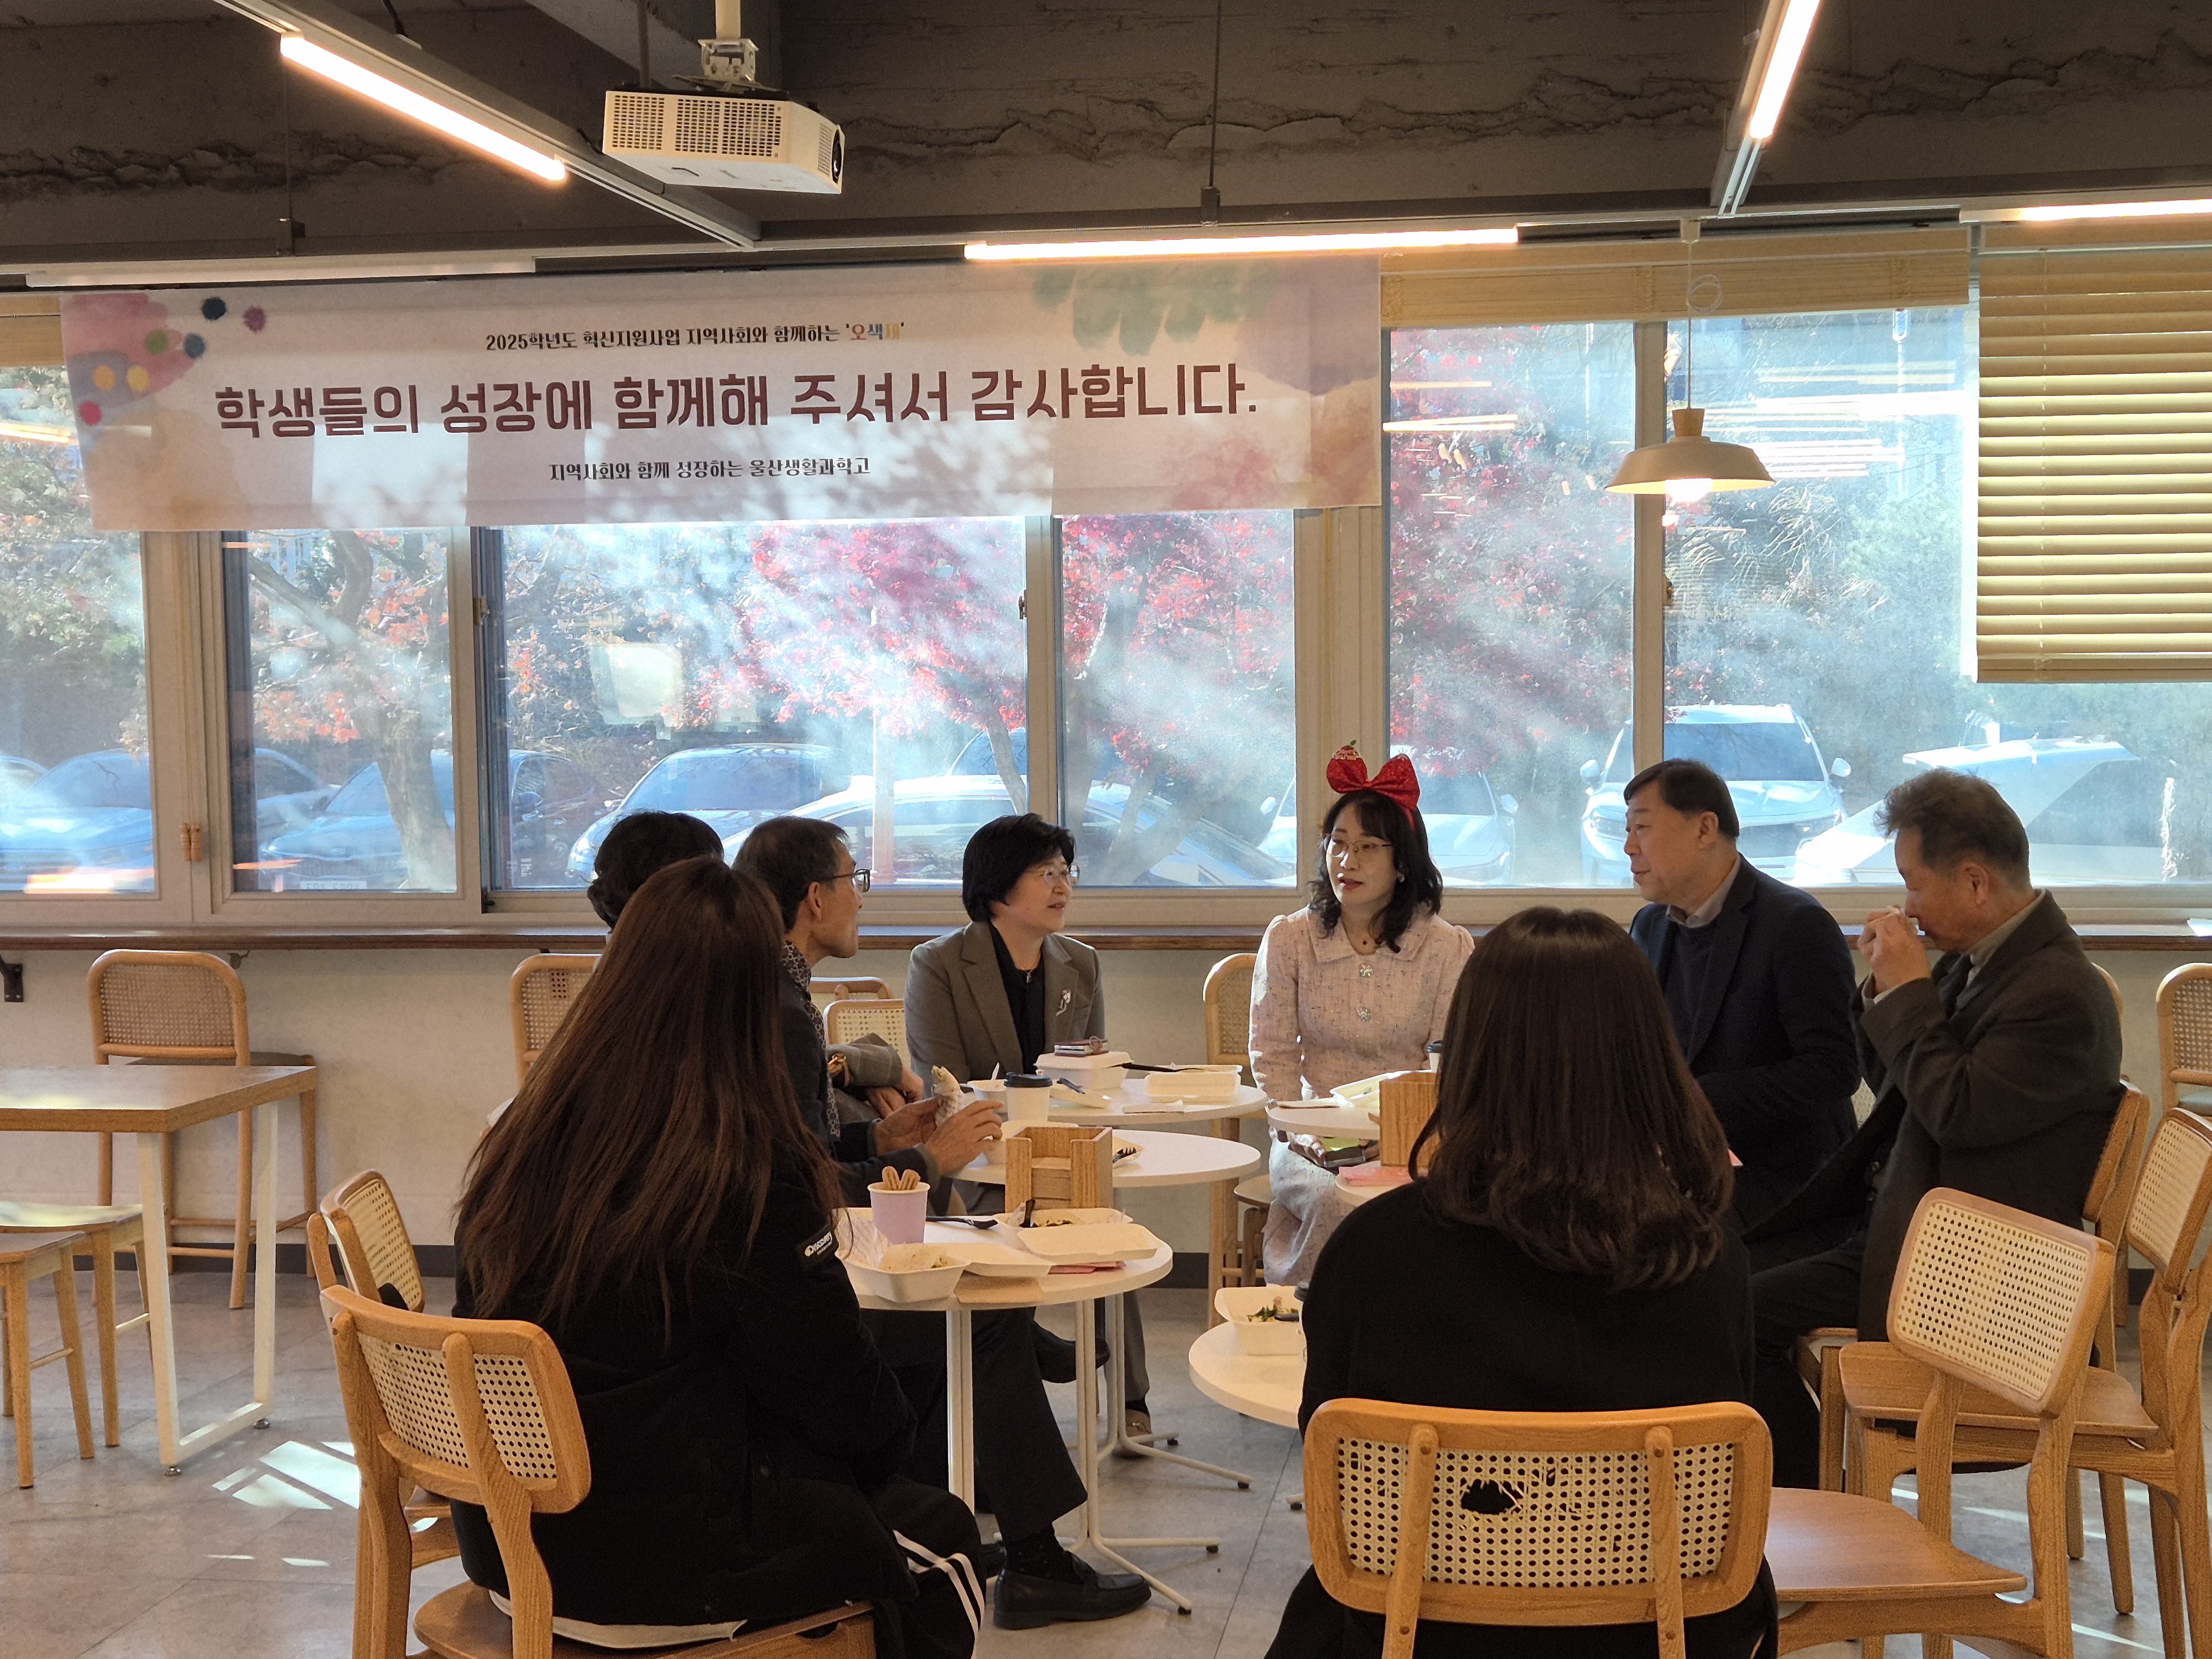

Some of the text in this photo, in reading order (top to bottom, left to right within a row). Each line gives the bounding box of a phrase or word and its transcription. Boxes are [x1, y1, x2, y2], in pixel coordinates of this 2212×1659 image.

[486, 332, 577, 351] 2025학년도
[583, 329, 680, 348] 혁신지원사업
[686, 327, 768, 345] 지역사회와
[774, 325, 840, 342] 함께하는
[215, 363, 1256, 438] 학생들의 성장에 함께해 주셔서 감사합니다.
[549, 458, 870, 481] 지역사회와 함께 성장하는 울산생활과학고
